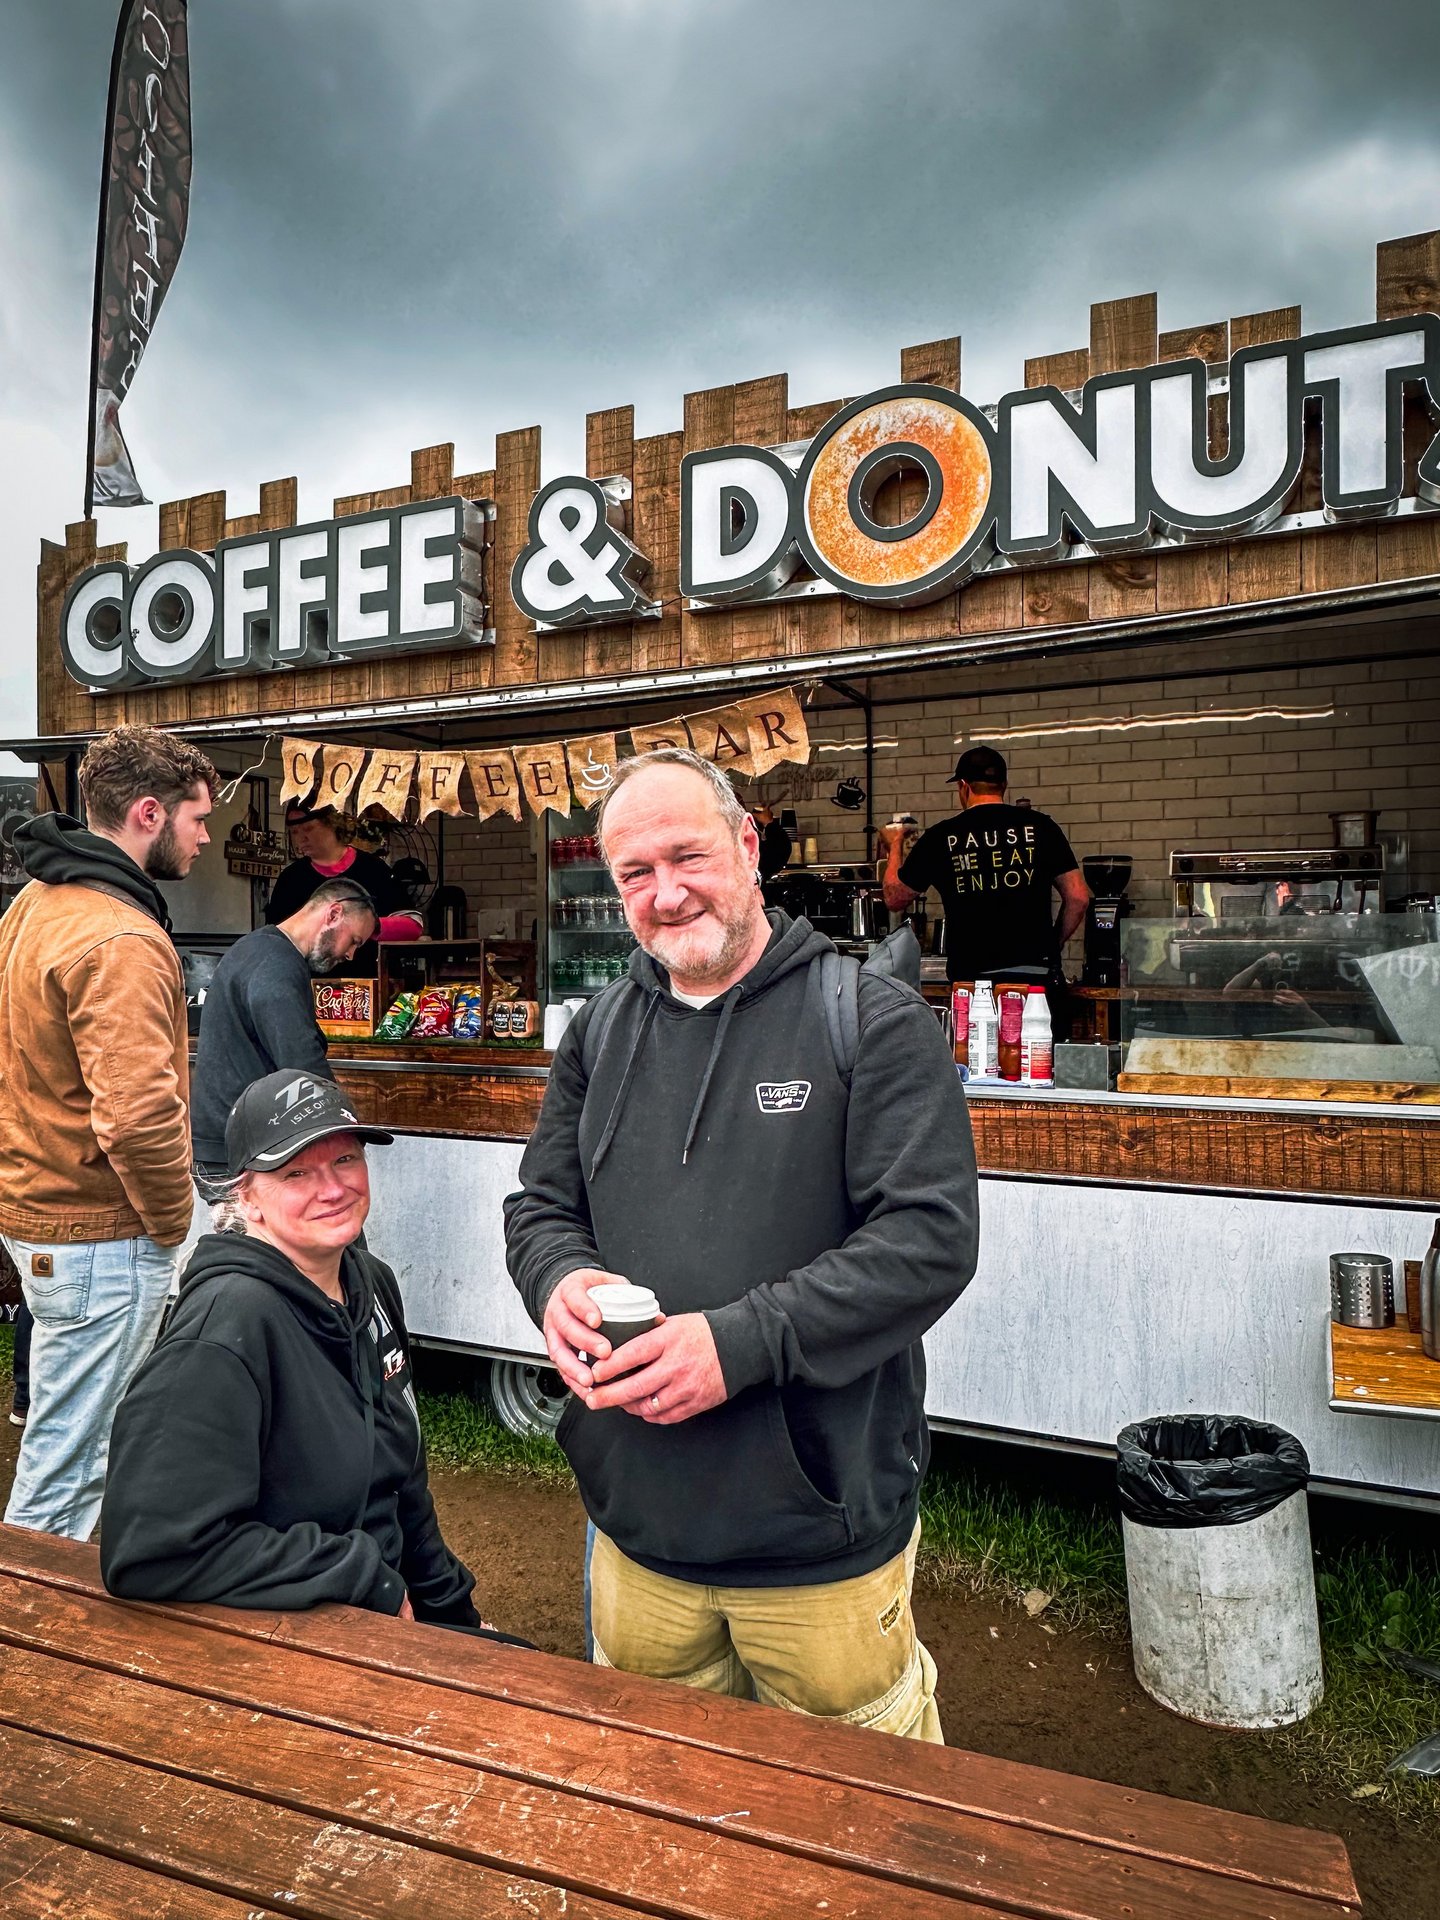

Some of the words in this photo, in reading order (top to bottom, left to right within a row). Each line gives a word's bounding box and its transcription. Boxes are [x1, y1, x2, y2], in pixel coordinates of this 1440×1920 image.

[62, 498, 462, 685] COFFEE
[516, 482, 631, 617] &
[682, 318, 1440, 598] DONUT
[291, 752, 559, 800] COFFEE
[947, 826, 1035, 852] PAUSE
[240, 862, 273, 876] BETTER
[992, 847, 1035, 868] EAT
[956, 868, 1035, 893] ENJOY
[768, 1085, 800, 1099] VANS
[290, 1106, 314, 1125] ISLE
